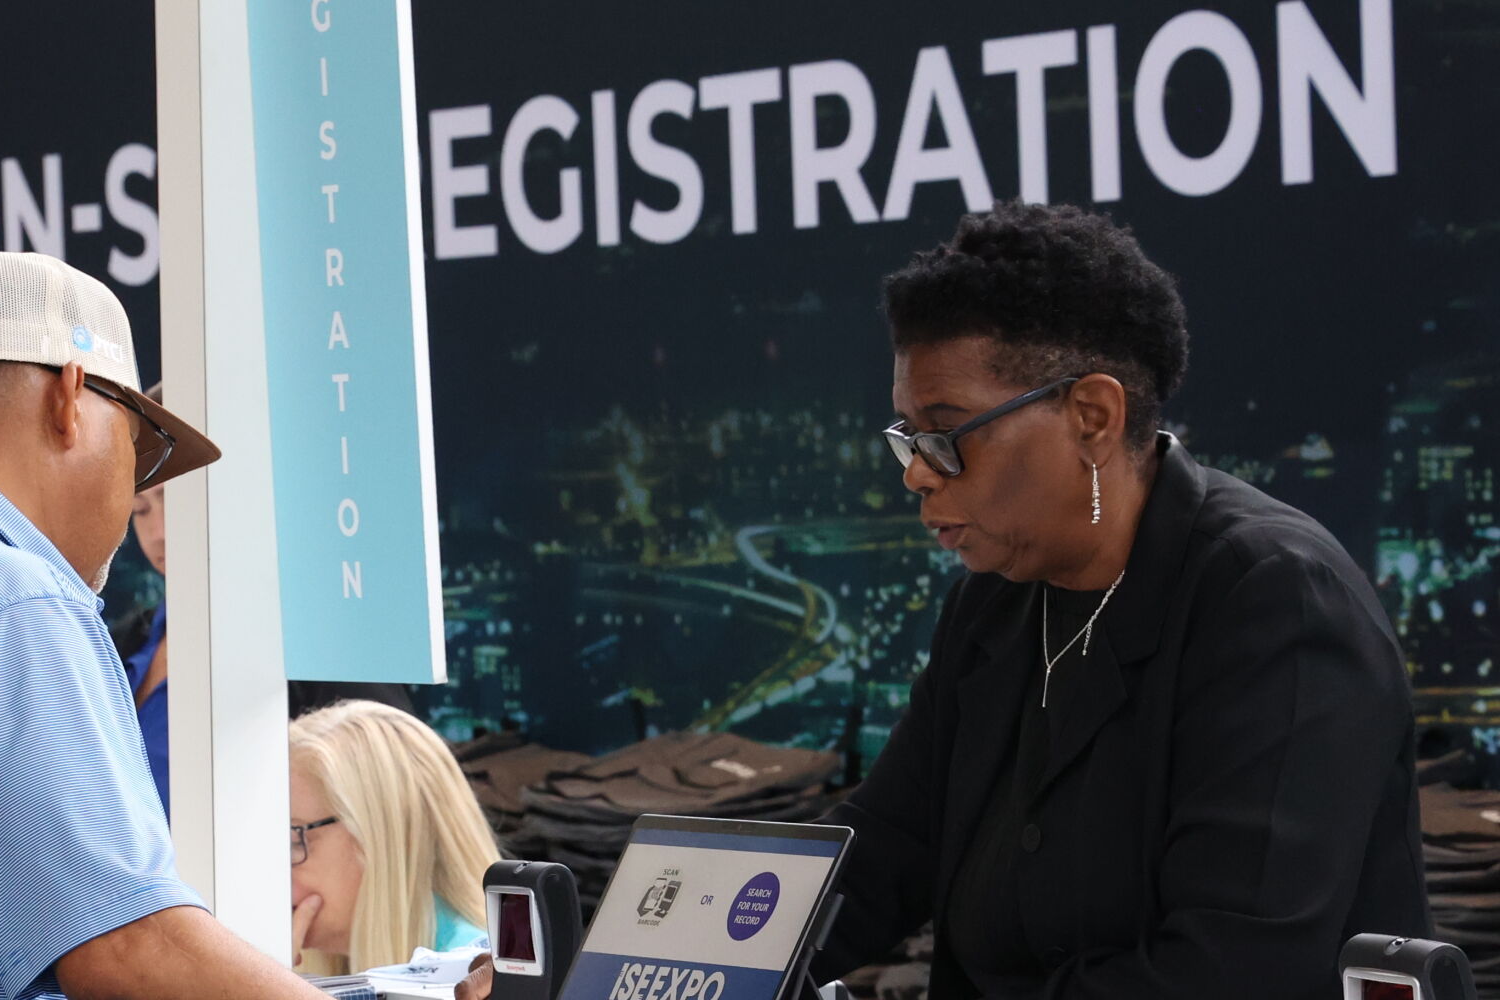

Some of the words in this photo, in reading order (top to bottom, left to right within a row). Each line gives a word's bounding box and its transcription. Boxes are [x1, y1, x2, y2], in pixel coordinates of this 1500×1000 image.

[419, 0, 1398, 260] EGISTRATION
[311, 0, 363, 598] GISTRATION
[746, 888, 772, 898] SEARCH
[700, 895, 714, 906] OR
[737, 901, 750, 911] FOR
[750, 902, 769, 912] YOUR
[734, 915, 760, 925] RECORD
